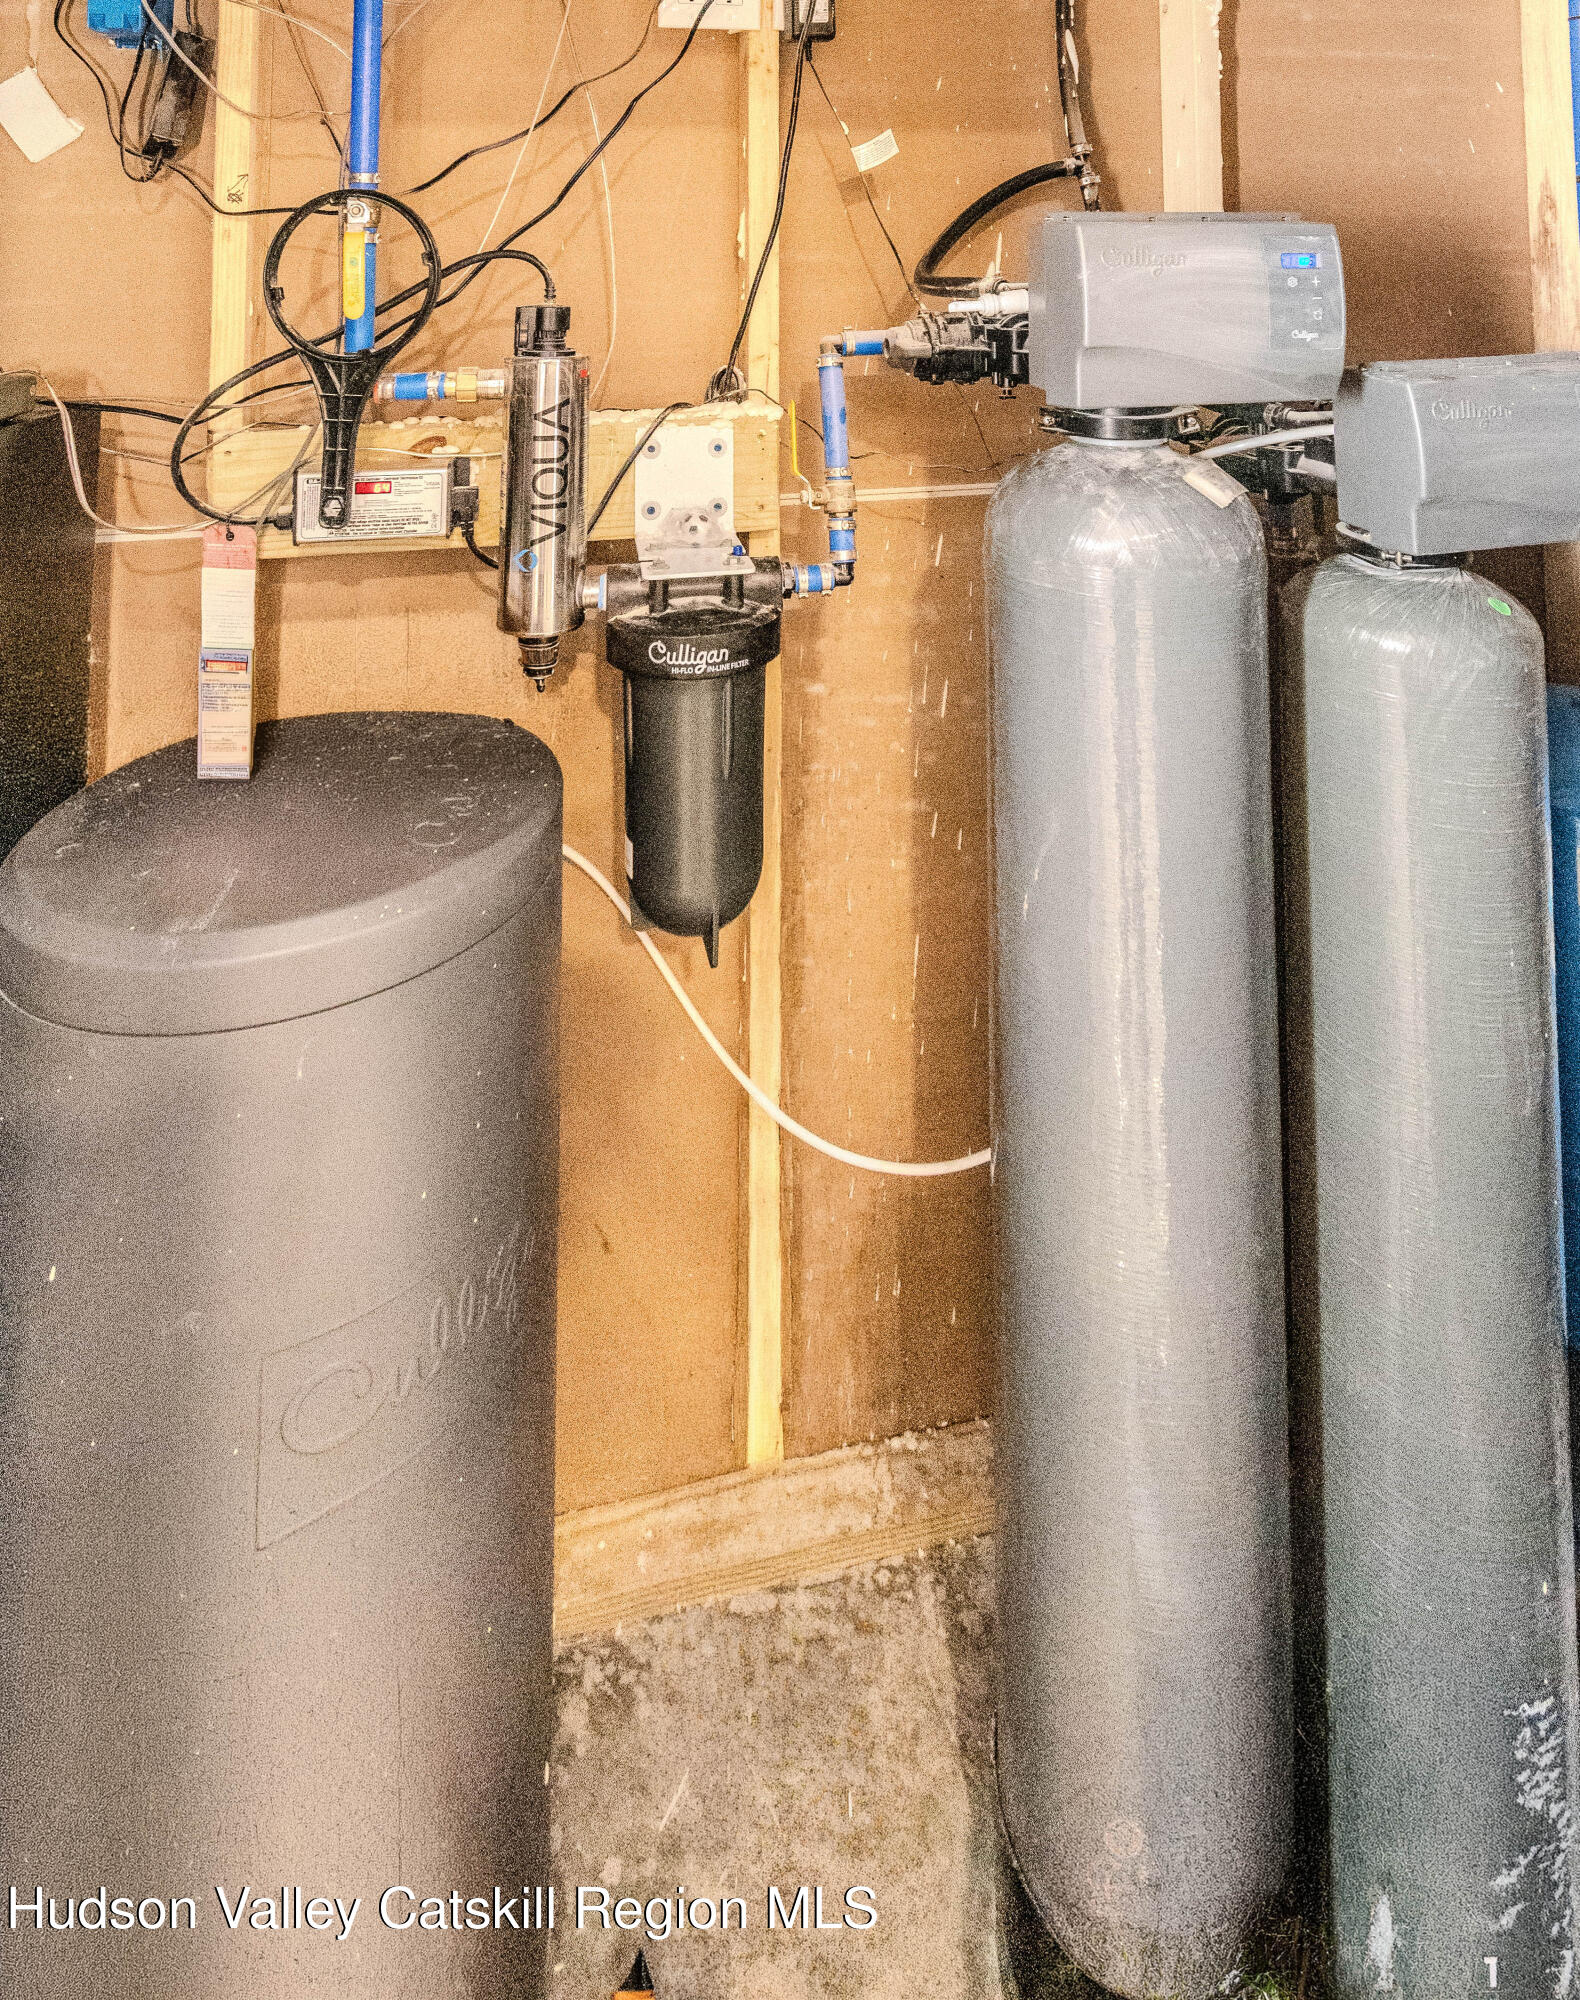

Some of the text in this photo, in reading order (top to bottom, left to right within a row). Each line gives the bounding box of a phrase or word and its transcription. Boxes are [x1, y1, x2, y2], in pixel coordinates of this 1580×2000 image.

[530, 397, 570, 547] VIQUA
[373, 483, 391, 493] 64
[648, 640, 729, 675] Culligan
[706, 662, 731, 673] IN-LINE
[730, 658, 750, 670] FILTER
